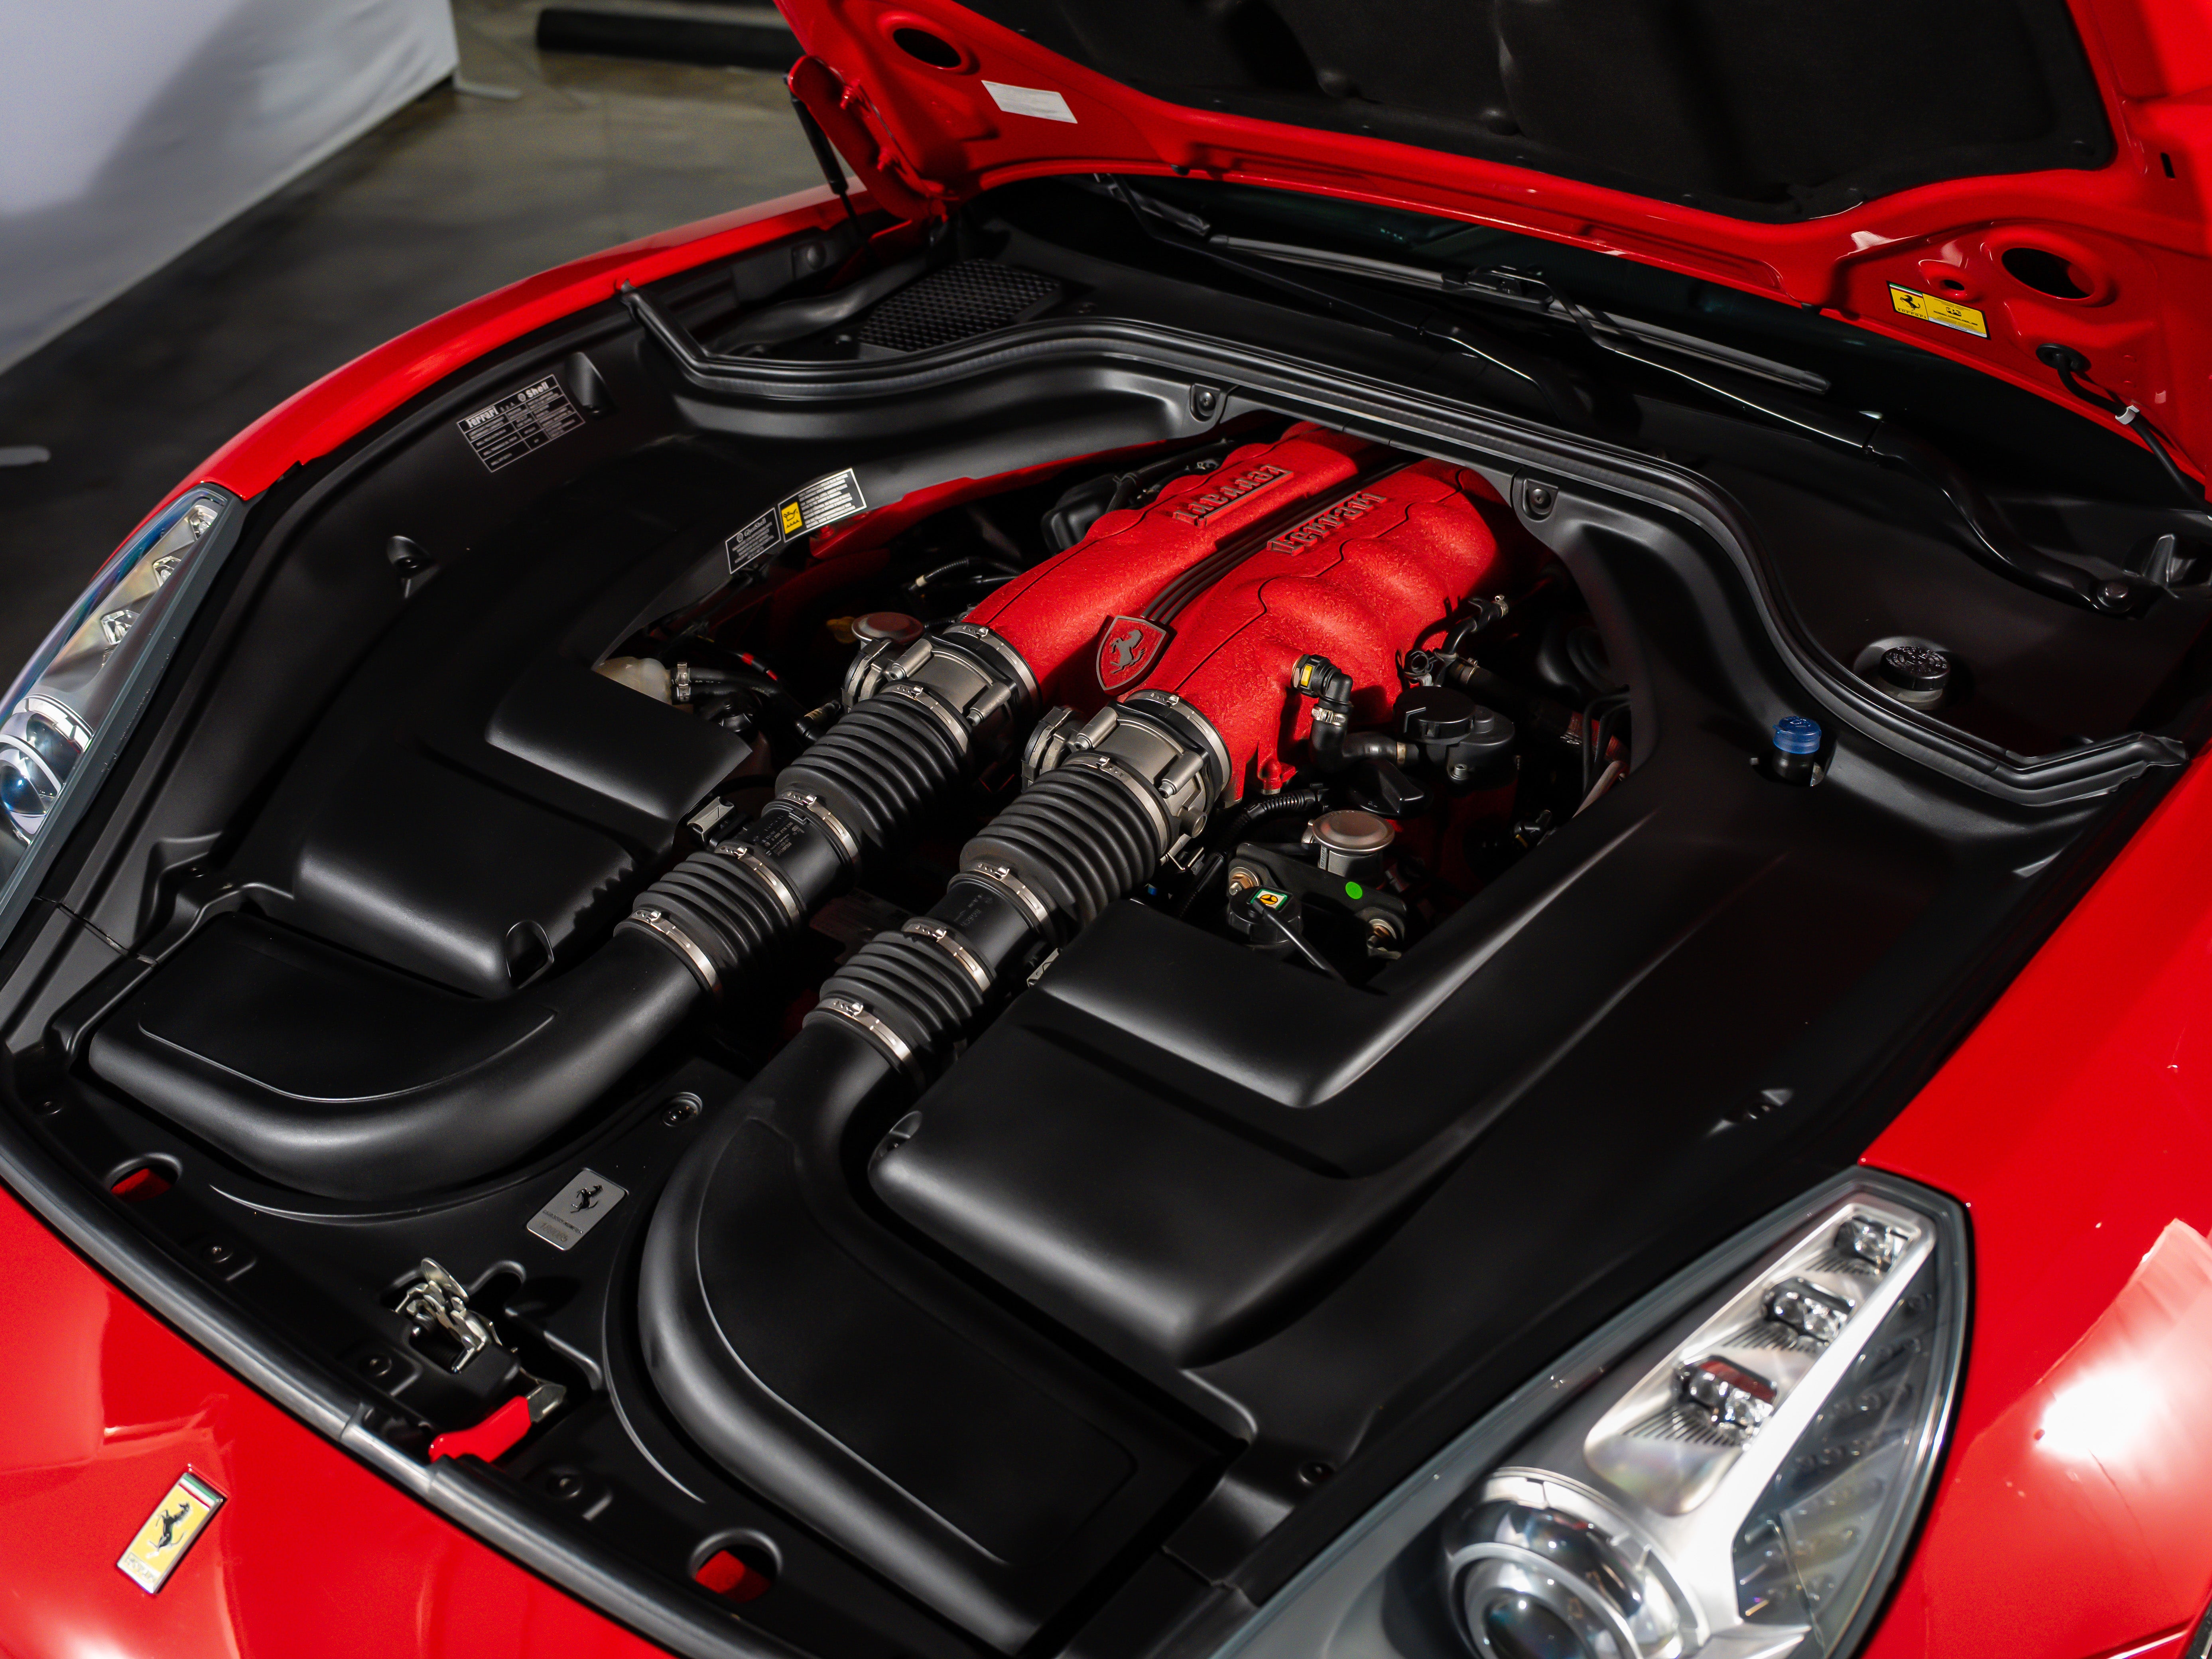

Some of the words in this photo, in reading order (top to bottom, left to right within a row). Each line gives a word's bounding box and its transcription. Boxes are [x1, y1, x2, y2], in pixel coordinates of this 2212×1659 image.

[1897, 307, 1926, 319] Ferrari
[525, 381, 549, 398] Shell
[465, 406, 499, 428] Ferrari
[1173, 464, 1294, 528] Ferrari
[1267, 491, 1387, 556] Ferrari
